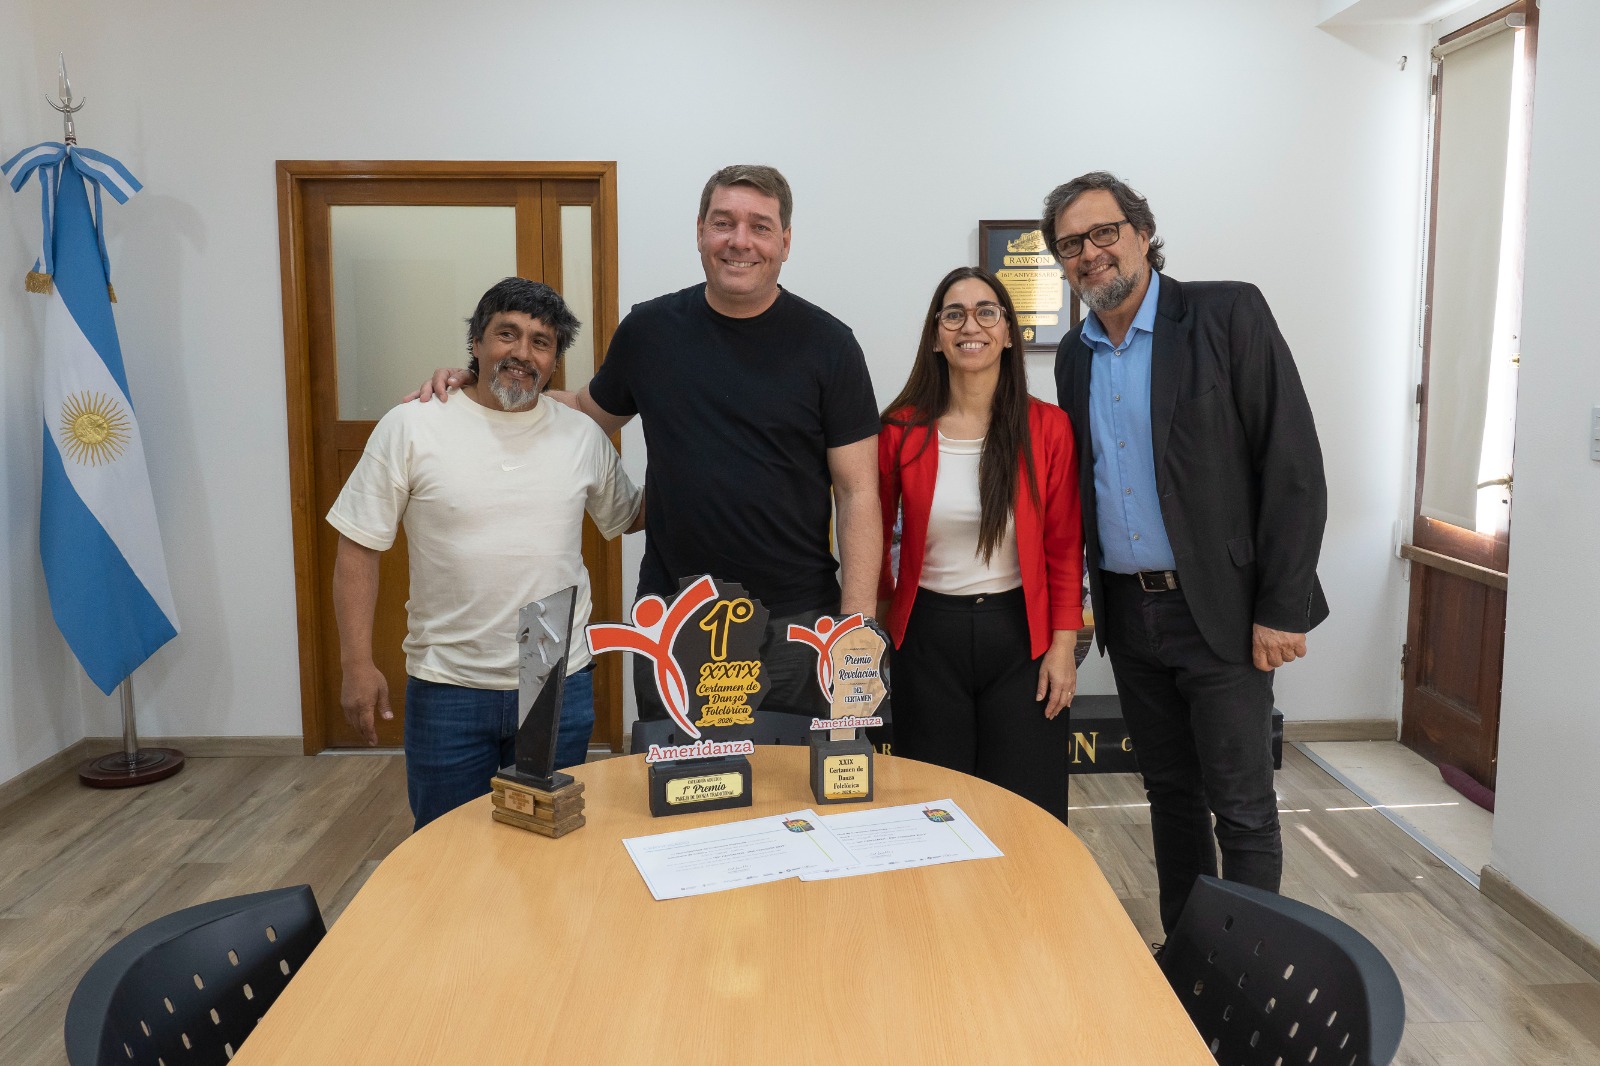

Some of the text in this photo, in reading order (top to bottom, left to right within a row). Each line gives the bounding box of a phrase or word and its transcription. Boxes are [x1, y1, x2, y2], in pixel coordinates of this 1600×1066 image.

[1009, 256, 1050, 264] RAWSON
[844, 654, 872, 666] Premio
[702, 662, 759, 681] XXIX
[838, 668, 879, 680] Revelación
[699, 680, 759, 694] Certamen de
[853, 686, 863, 694] DEL
[711, 694, 745, 705] Danza
[844, 694, 872, 703] CERTAMEN
[704, 704, 750, 717] Folclórica
[811, 717, 881, 729] Ameridanza
[649, 742, 752, 761] Ameridanza
[1068, 731, 1099, 764] N
[838, 758, 854, 766] XXIX
[693, 782, 727, 794] Premio
